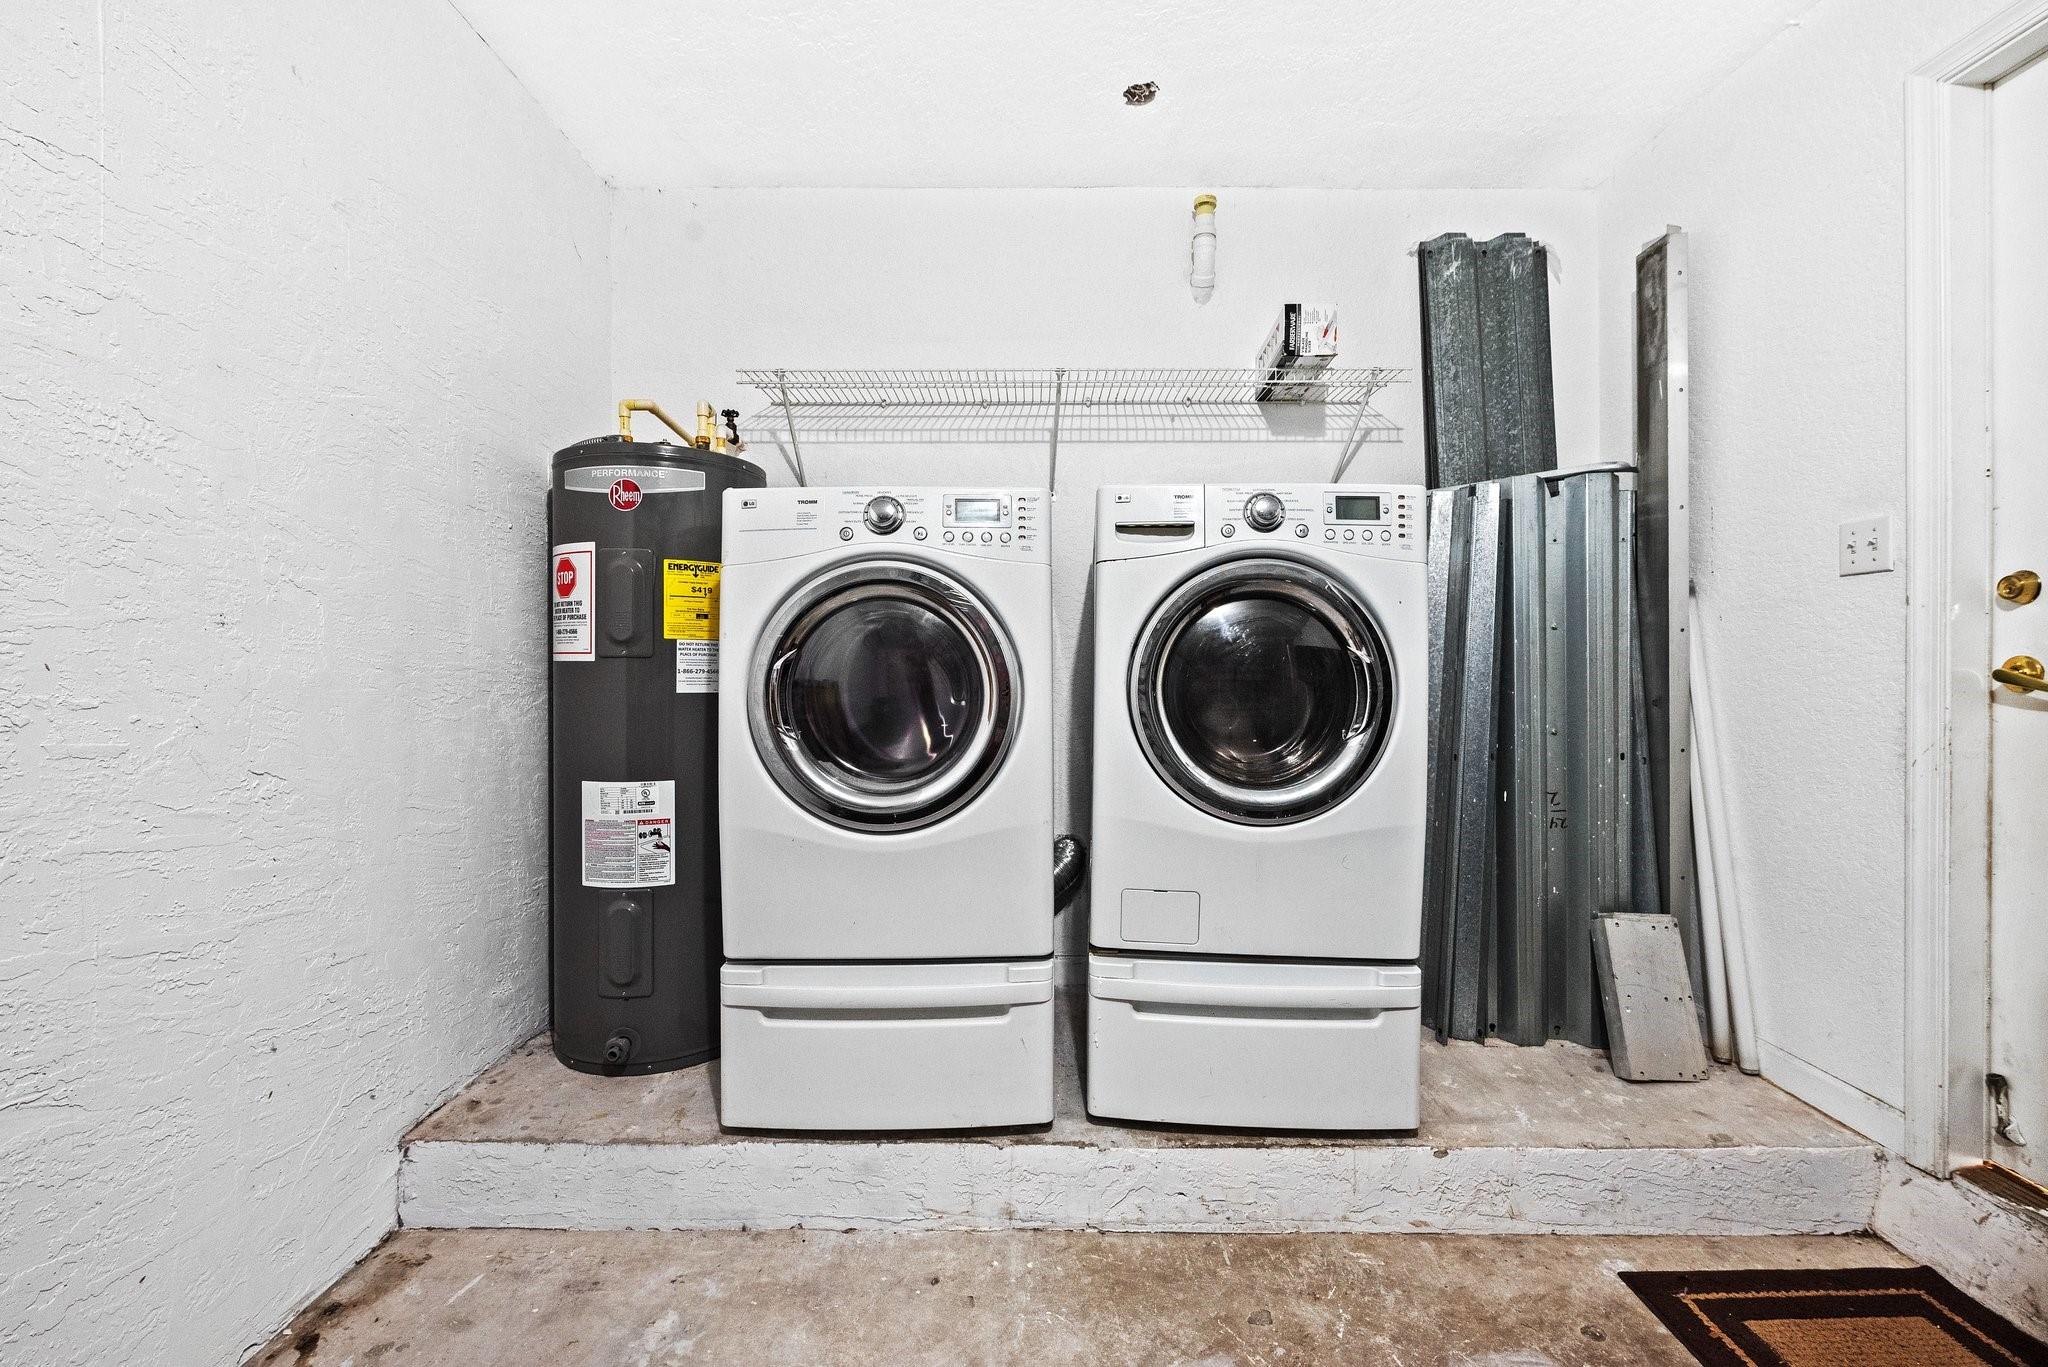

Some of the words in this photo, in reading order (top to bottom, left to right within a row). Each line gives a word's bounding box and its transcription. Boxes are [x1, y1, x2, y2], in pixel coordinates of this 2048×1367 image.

[591, 468, 666, 479] PERFORMANCE
[612, 480, 640, 506] Rheem
[668, 562, 719, 574] ENERGYGUIDE
[557, 571, 574, 585] STOP
